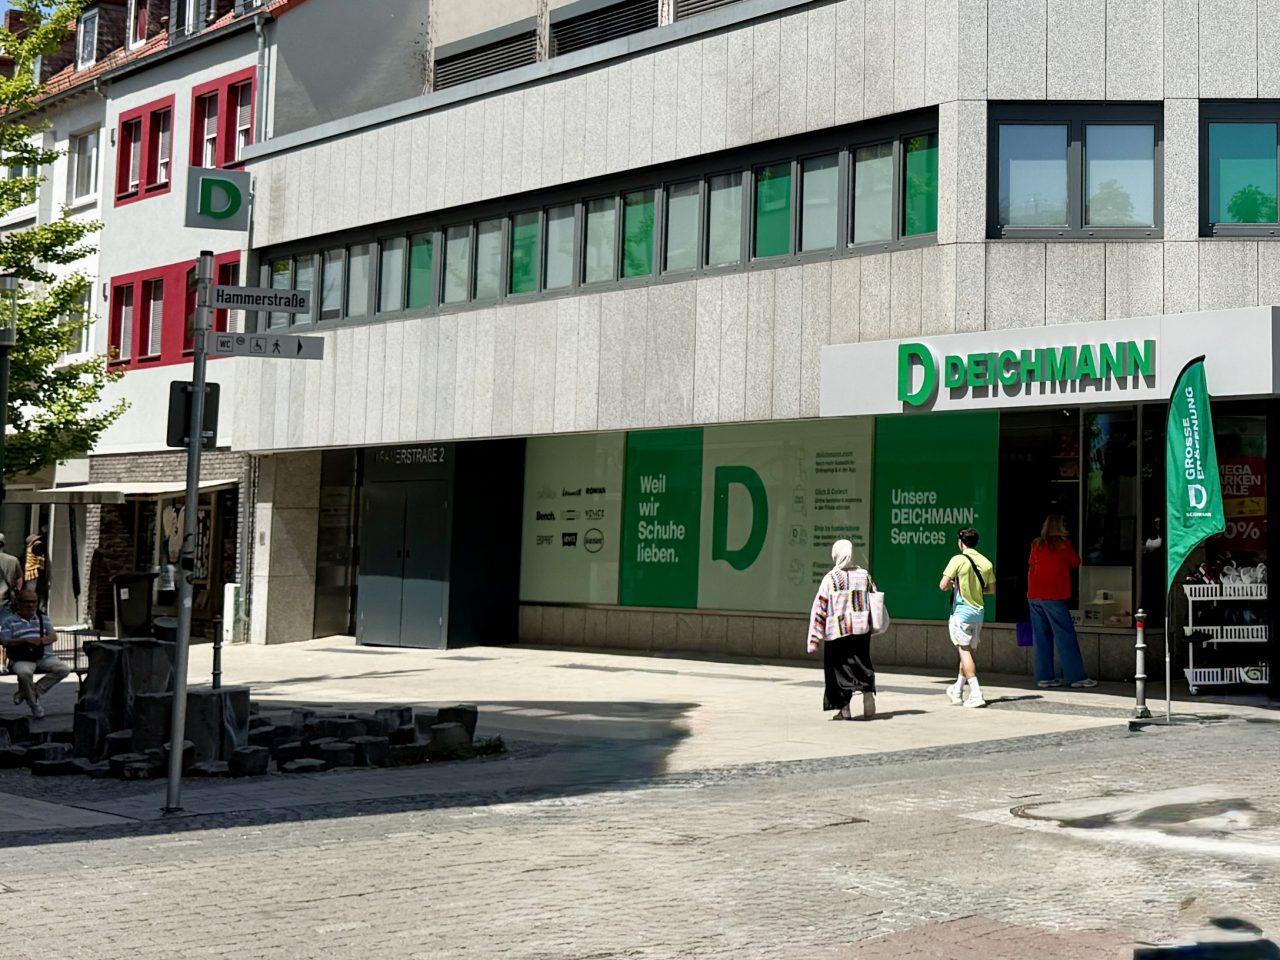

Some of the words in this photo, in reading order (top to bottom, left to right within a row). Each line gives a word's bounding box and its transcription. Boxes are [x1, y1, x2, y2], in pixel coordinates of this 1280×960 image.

[198, 177, 242, 220] D
[216, 288, 306, 308] Hammerstraße
[220, 339, 231, 349] WC
[898, 342, 938, 406] D
[944, 339, 1157, 388] DEICHMANN
[439, 447, 445, 462] 2
[1183, 417, 1196, 480] GROSSE
[640, 474, 666, 493] Weil
[1221, 475, 1261, 486] RKEN
[892, 489, 937, 505] Unsere
[1188, 483, 1208, 510] D
[1223, 486, 1249, 495] ALE
[639, 497, 660, 516] wir
[712, 465, 769, 571] D
[891, 508, 979, 525] DEICHMANN-
[638, 521, 686, 540] Schuhe
[891, 527, 946, 545] Services
[637, 543, 679, 563] lieben.
